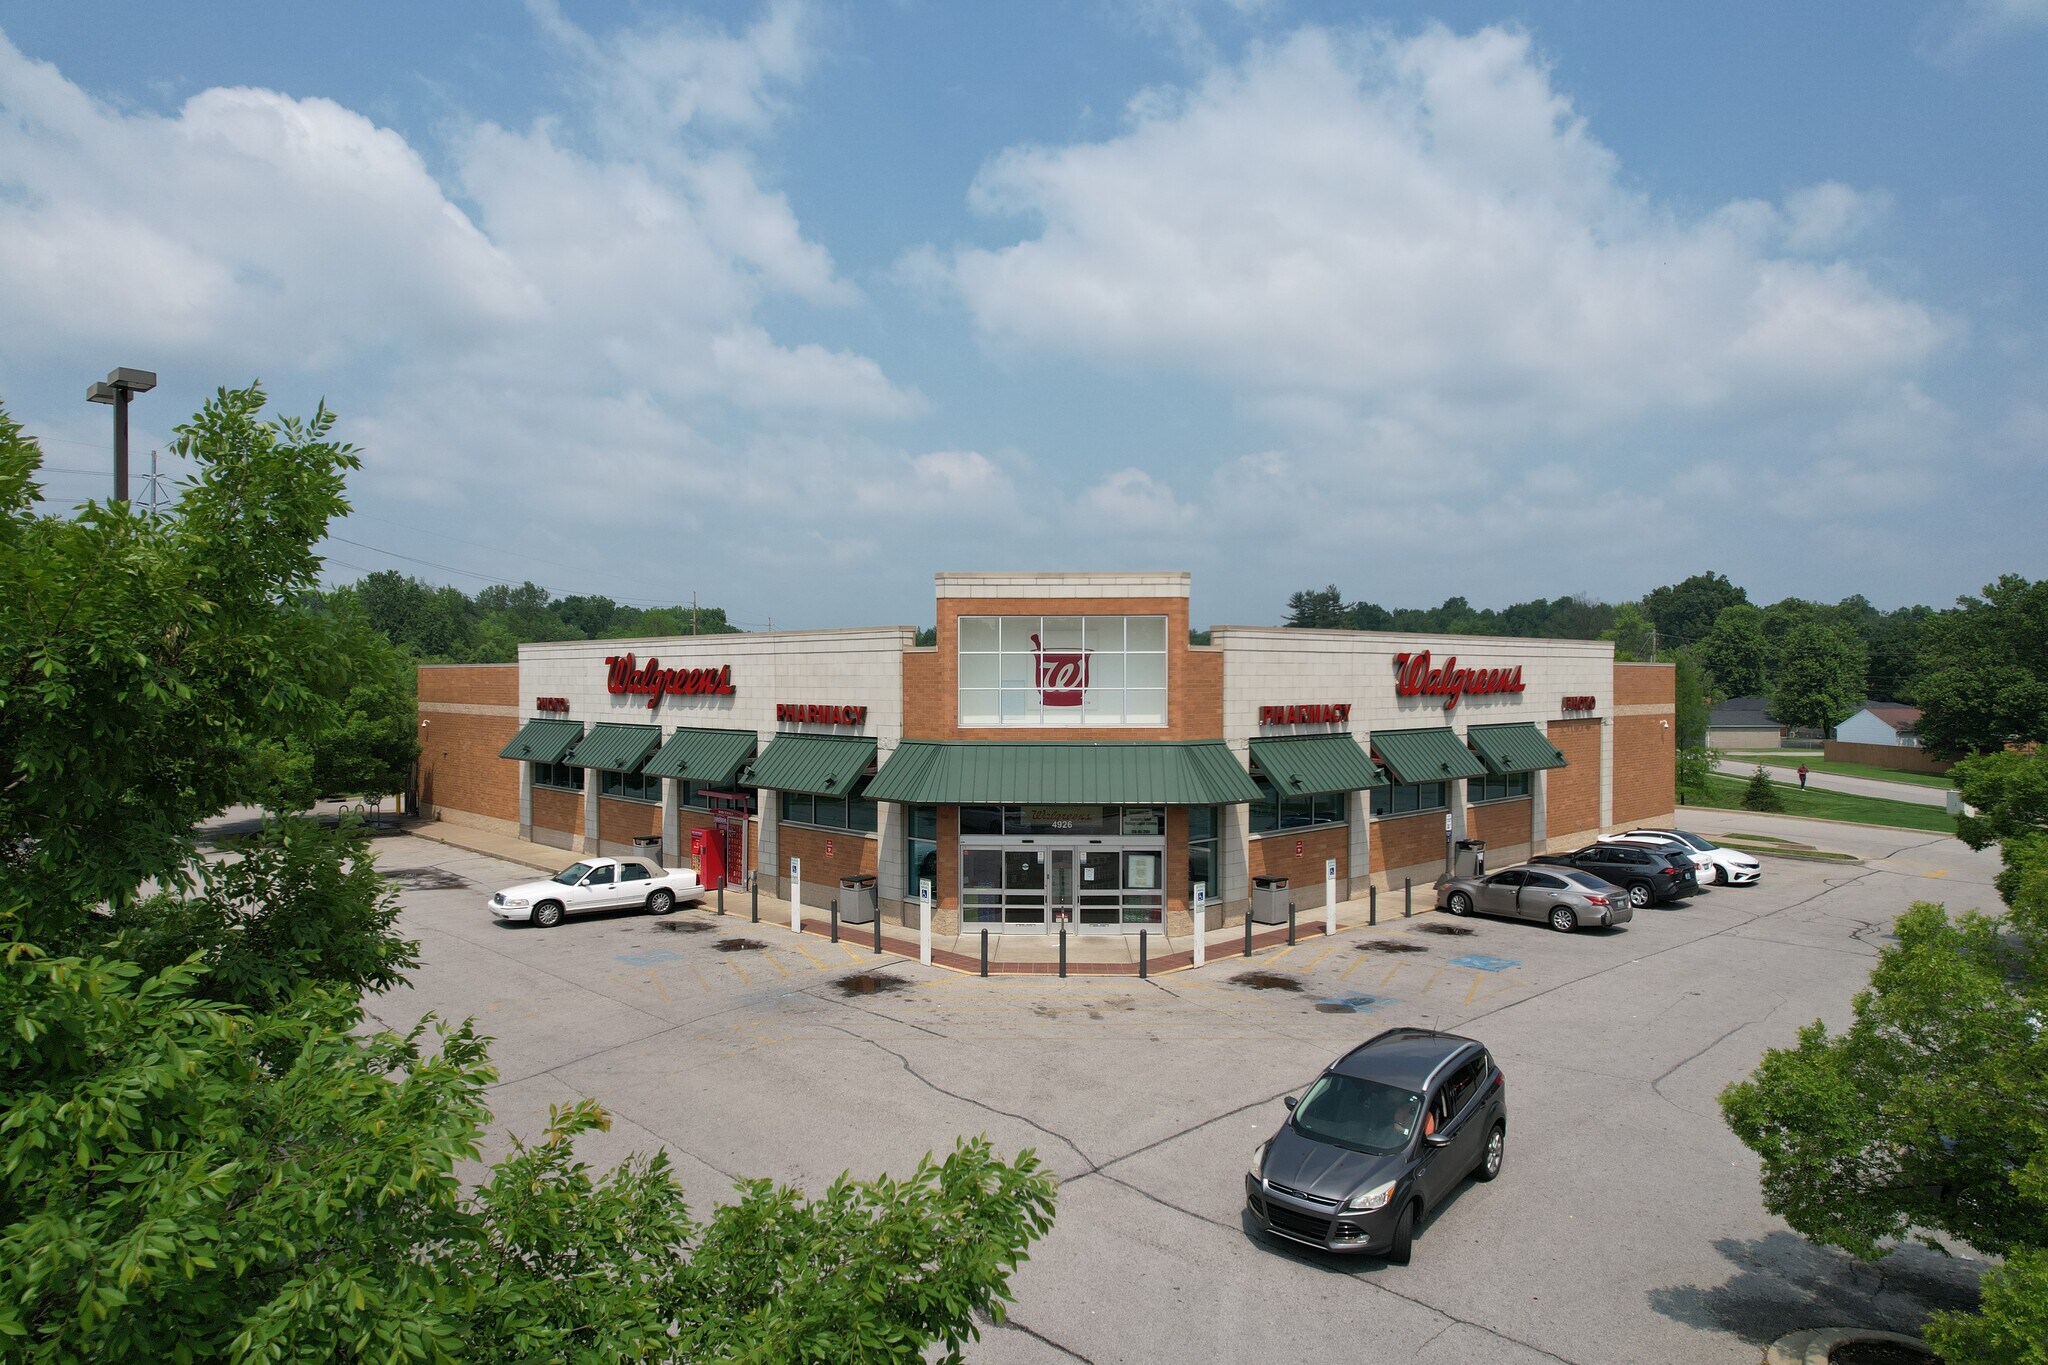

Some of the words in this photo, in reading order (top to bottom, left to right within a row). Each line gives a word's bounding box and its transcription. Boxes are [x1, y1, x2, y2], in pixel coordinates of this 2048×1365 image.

[605, 653, 736, 709] Walgreens
[1039, 659, 1085, 692] W
[1393, 650, 1526, 710] Walgreens
[537, 697, 569, 712] PHOTO
[1563, 696, 1596, 710] PHOTO
[777, 704, 867, 725] PHARMACY
[1260, 703, 1351, 725] PHARMACY
[1032, 810, 1092, 821] Walgreens
[1052, 820, 1072, 829] 4926
